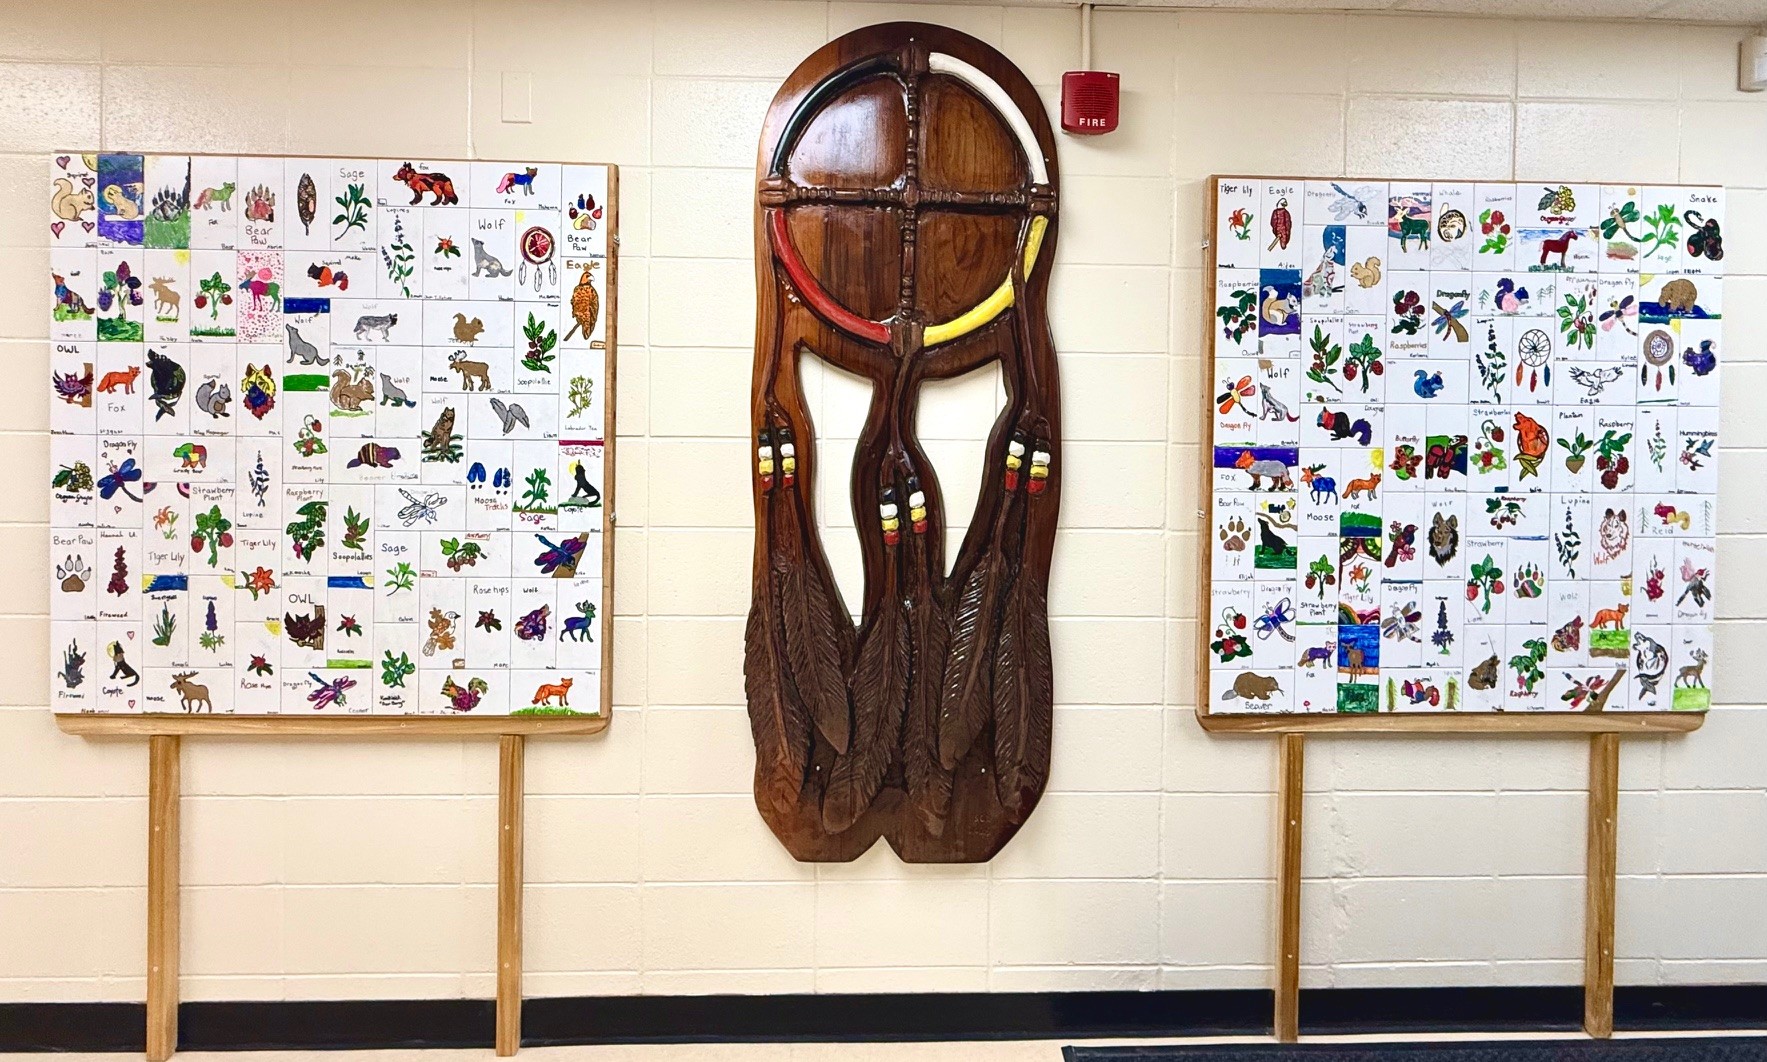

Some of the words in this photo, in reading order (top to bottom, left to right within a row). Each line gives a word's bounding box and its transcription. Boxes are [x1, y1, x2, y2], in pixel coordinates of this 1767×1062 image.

[1079, 118, 1106, 126] FIRE
[340, 168, 364, 181] Sage
[1220, 185, 1238, 194] Tiger
[1242, 186, 1252, 197] lily
[1269, 186, 1294, 196] Eagle
[1690, 194, 1717, 203] Snake
[478, 219, 505, 230] Wolf
[245, 226, 272, 235] Bear
[251, 236, 267, 245] Paw
[568, 234, 592, 242] Bear
[572, 242, 587, 251] Paw
[566, 260, 600, 270] Eagle
[1437, 290, 1470, 300] Dragonfly
[57, 345, 79, 354] OWL
[1390, 341, 1427, 350] Raspberries
[1267, 368, 1290, 379] Wolf
[108, 403, 126, 412] Fox
[103, 441, 126, 450] Dragon
[192, 487, 234, 498] Strawberry
[286, 489, 323, 497] Raspberry
[1561, 496, 1590, 506] Lupine
[519, 512, 546, 524] Sage
[1307, 513, 1334, 521] Moose
[1652, 527, 1673, 535] Reid
[53, 536, 76, 545] Bear
[78, 536, 93, 544] Paw
[240, 539, 262, 550] Tiger
[262, 539, 276, 550] Lily
[381, 543, 408, 556] Sage
[149, 552, 168, 565] Tiger
[170, 551, 185, 566] Lily
[473, 585, 492, 594] Rose
[493, 585, 509, 595] hips
[289, 594, 315, 604] OWL
[1309, 609, 1326, 617] Plant
[240, 679, 258, 688] Rose
[102, 687, 123, 696] Coyote
